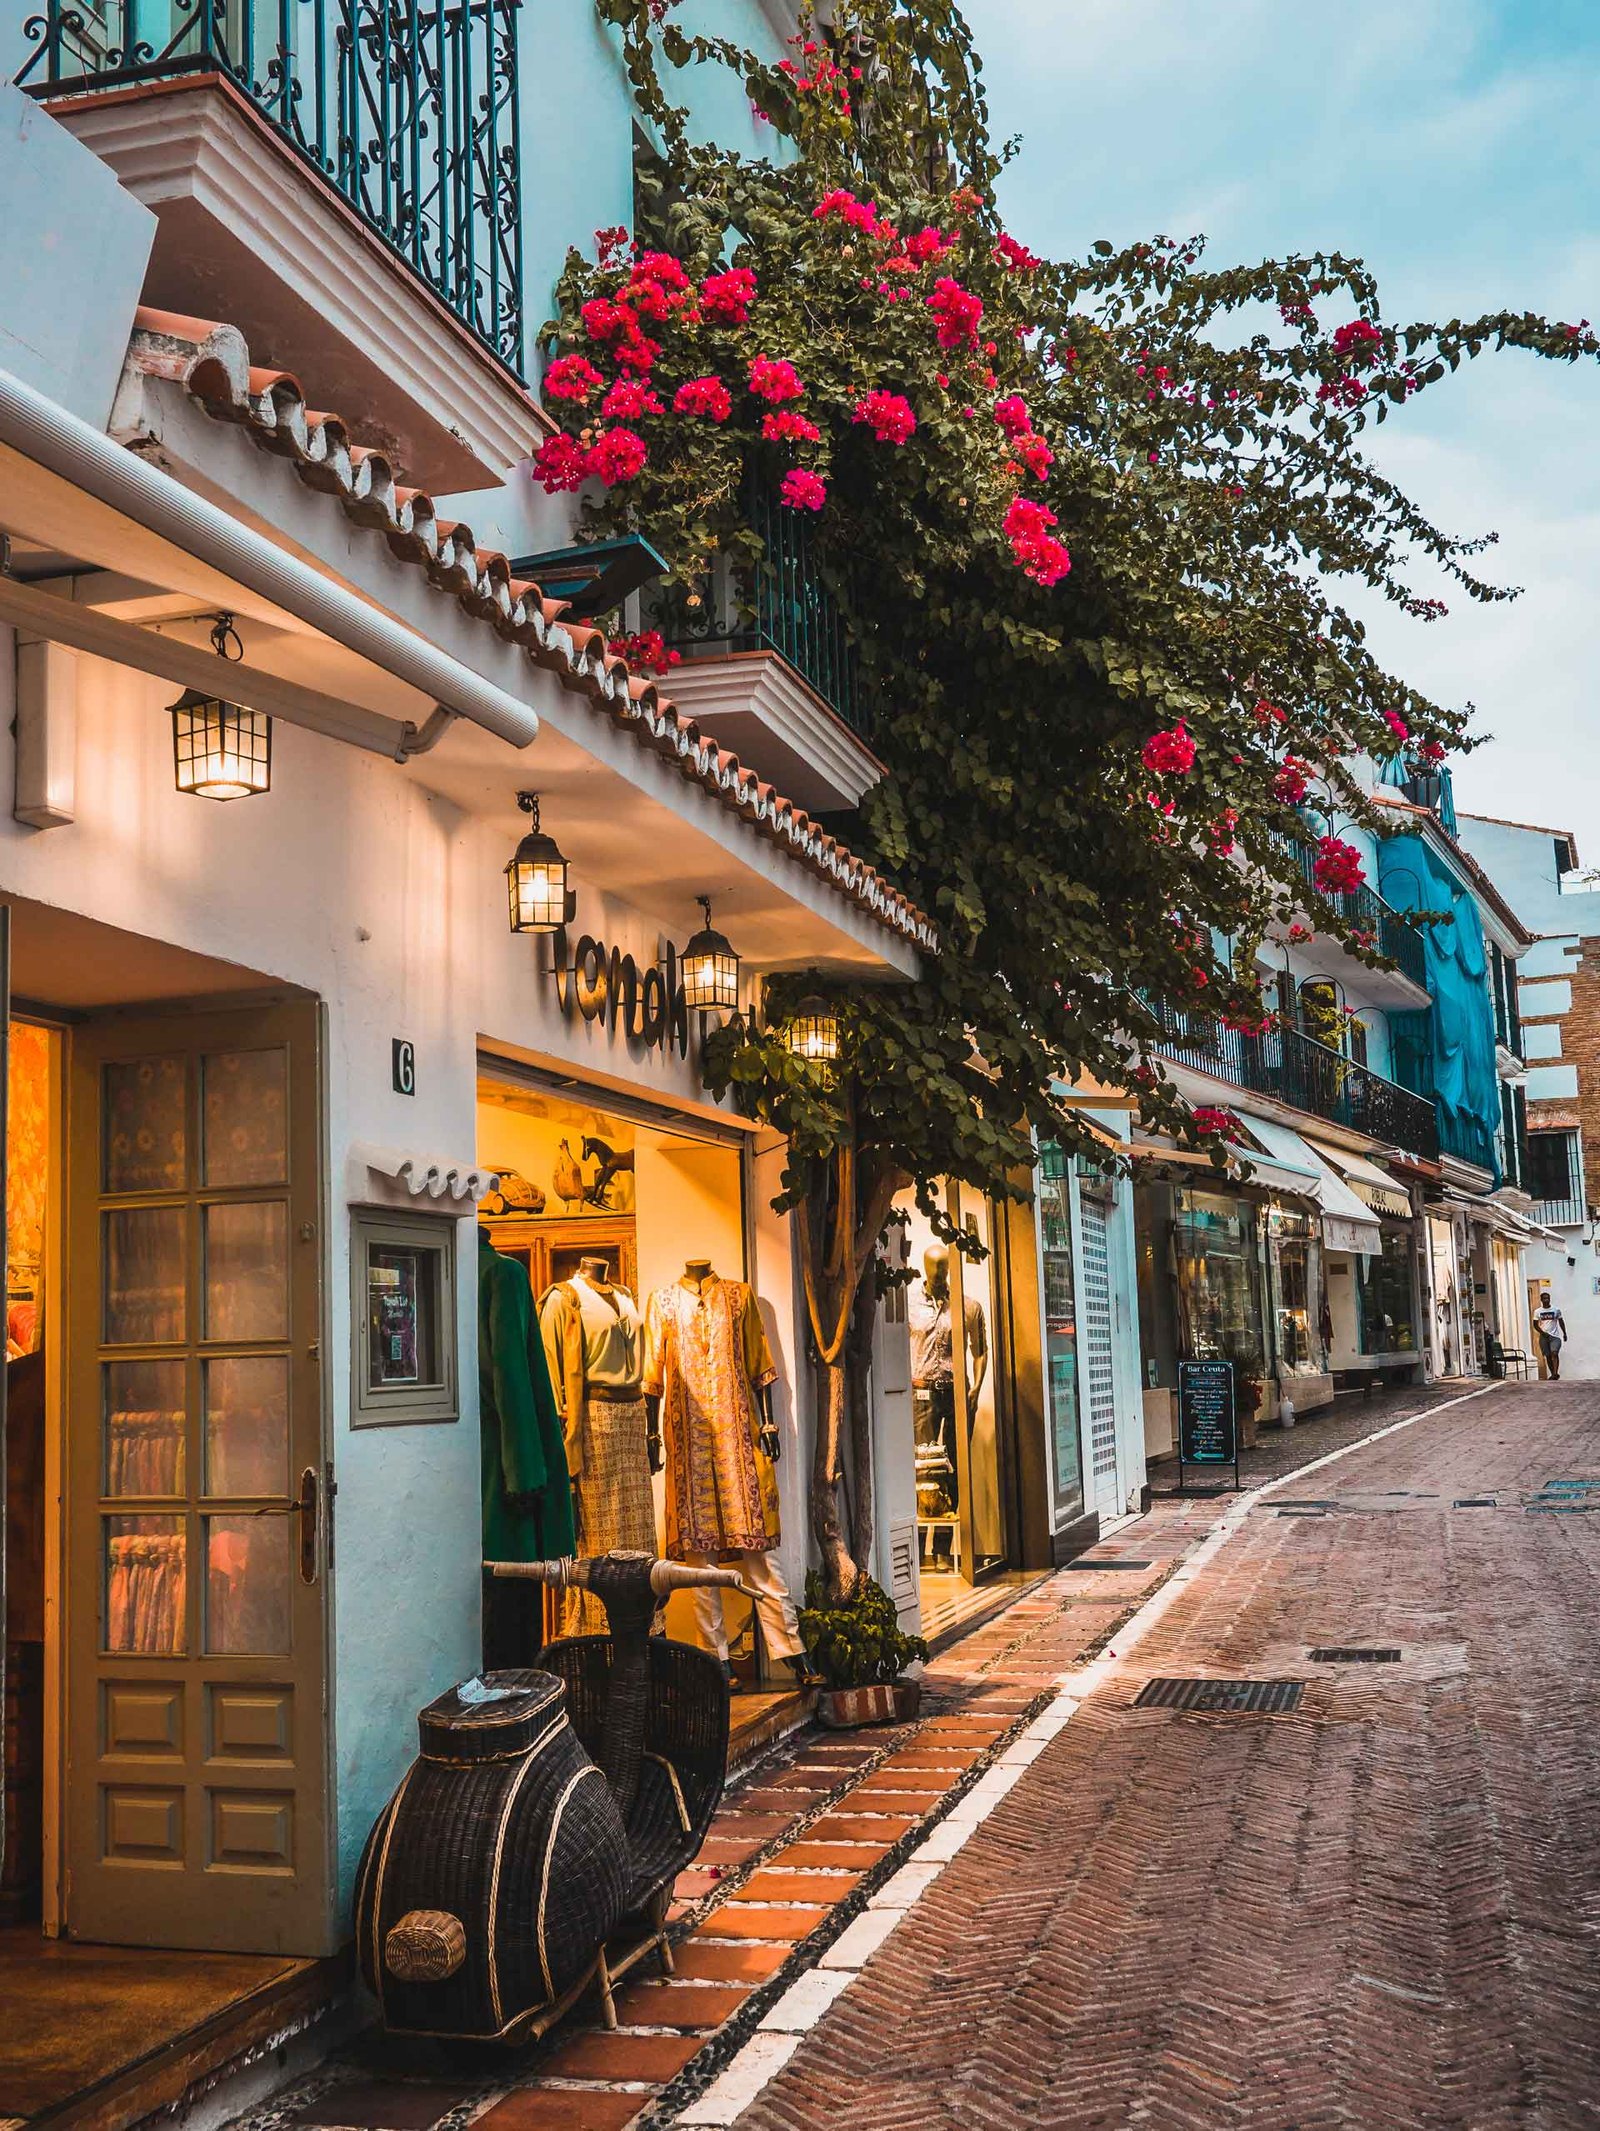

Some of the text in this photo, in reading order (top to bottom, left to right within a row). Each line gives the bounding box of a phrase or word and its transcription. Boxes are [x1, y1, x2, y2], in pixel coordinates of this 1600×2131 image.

[399, 1042, 413, 1093] 6
[1187, 1365, 1226, 1373] Bar Ceuta
